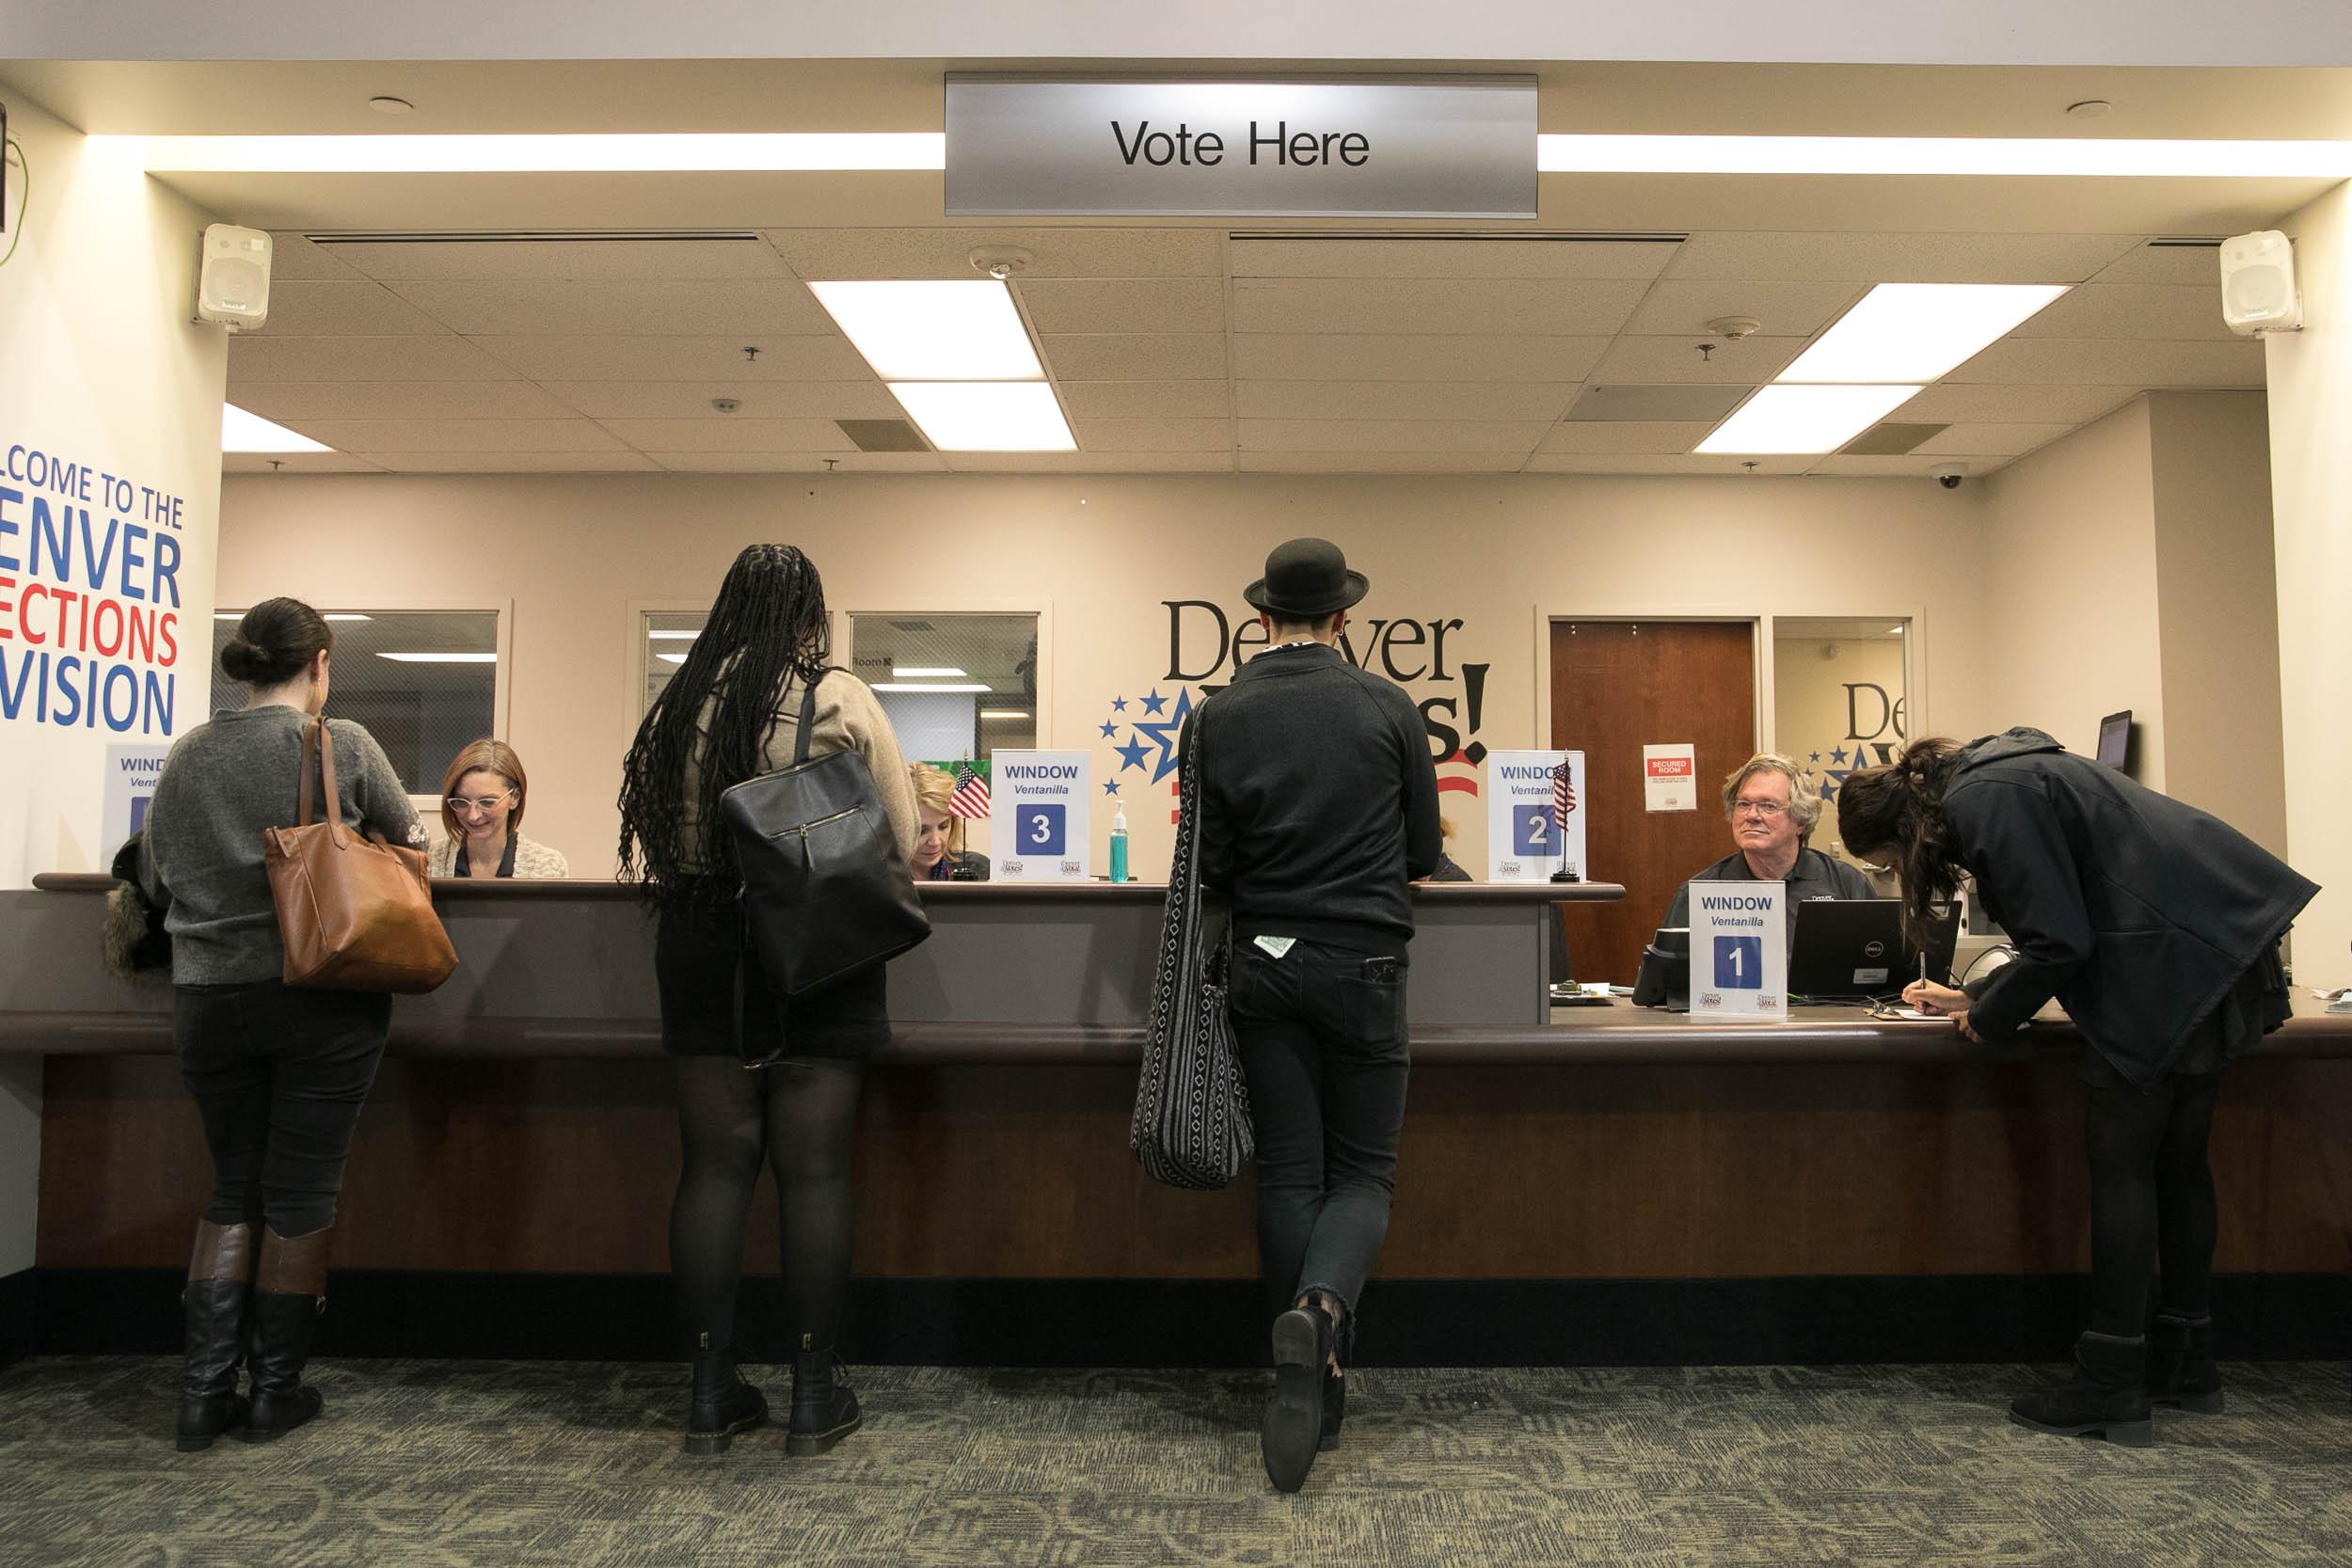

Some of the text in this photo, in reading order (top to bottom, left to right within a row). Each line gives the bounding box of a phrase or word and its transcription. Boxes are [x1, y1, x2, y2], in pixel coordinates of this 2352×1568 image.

[1110, 120, 1370, 166] Vote Here
[0, 444, 184, 531] COME TO THE
[1161, 600, 1465, 683] Dever
[0, 645, 175, 736] VISION
[1005, 766, 1078, 779] WINDOW
[1501, 767, 1555, 780] WINDO
[1015, 784, 1069, 795] Ventanilla
[1511, 785, 1554, 795] Ventanil
[1031, 815, 1051, 846] 3
[1528, 816, 1548, 845] 2
[1701, 897, 1772, 911] WINDOW
[1711, 916, 1763, 927] Ventanilla
[1729, 947, 1742, 977] 1
